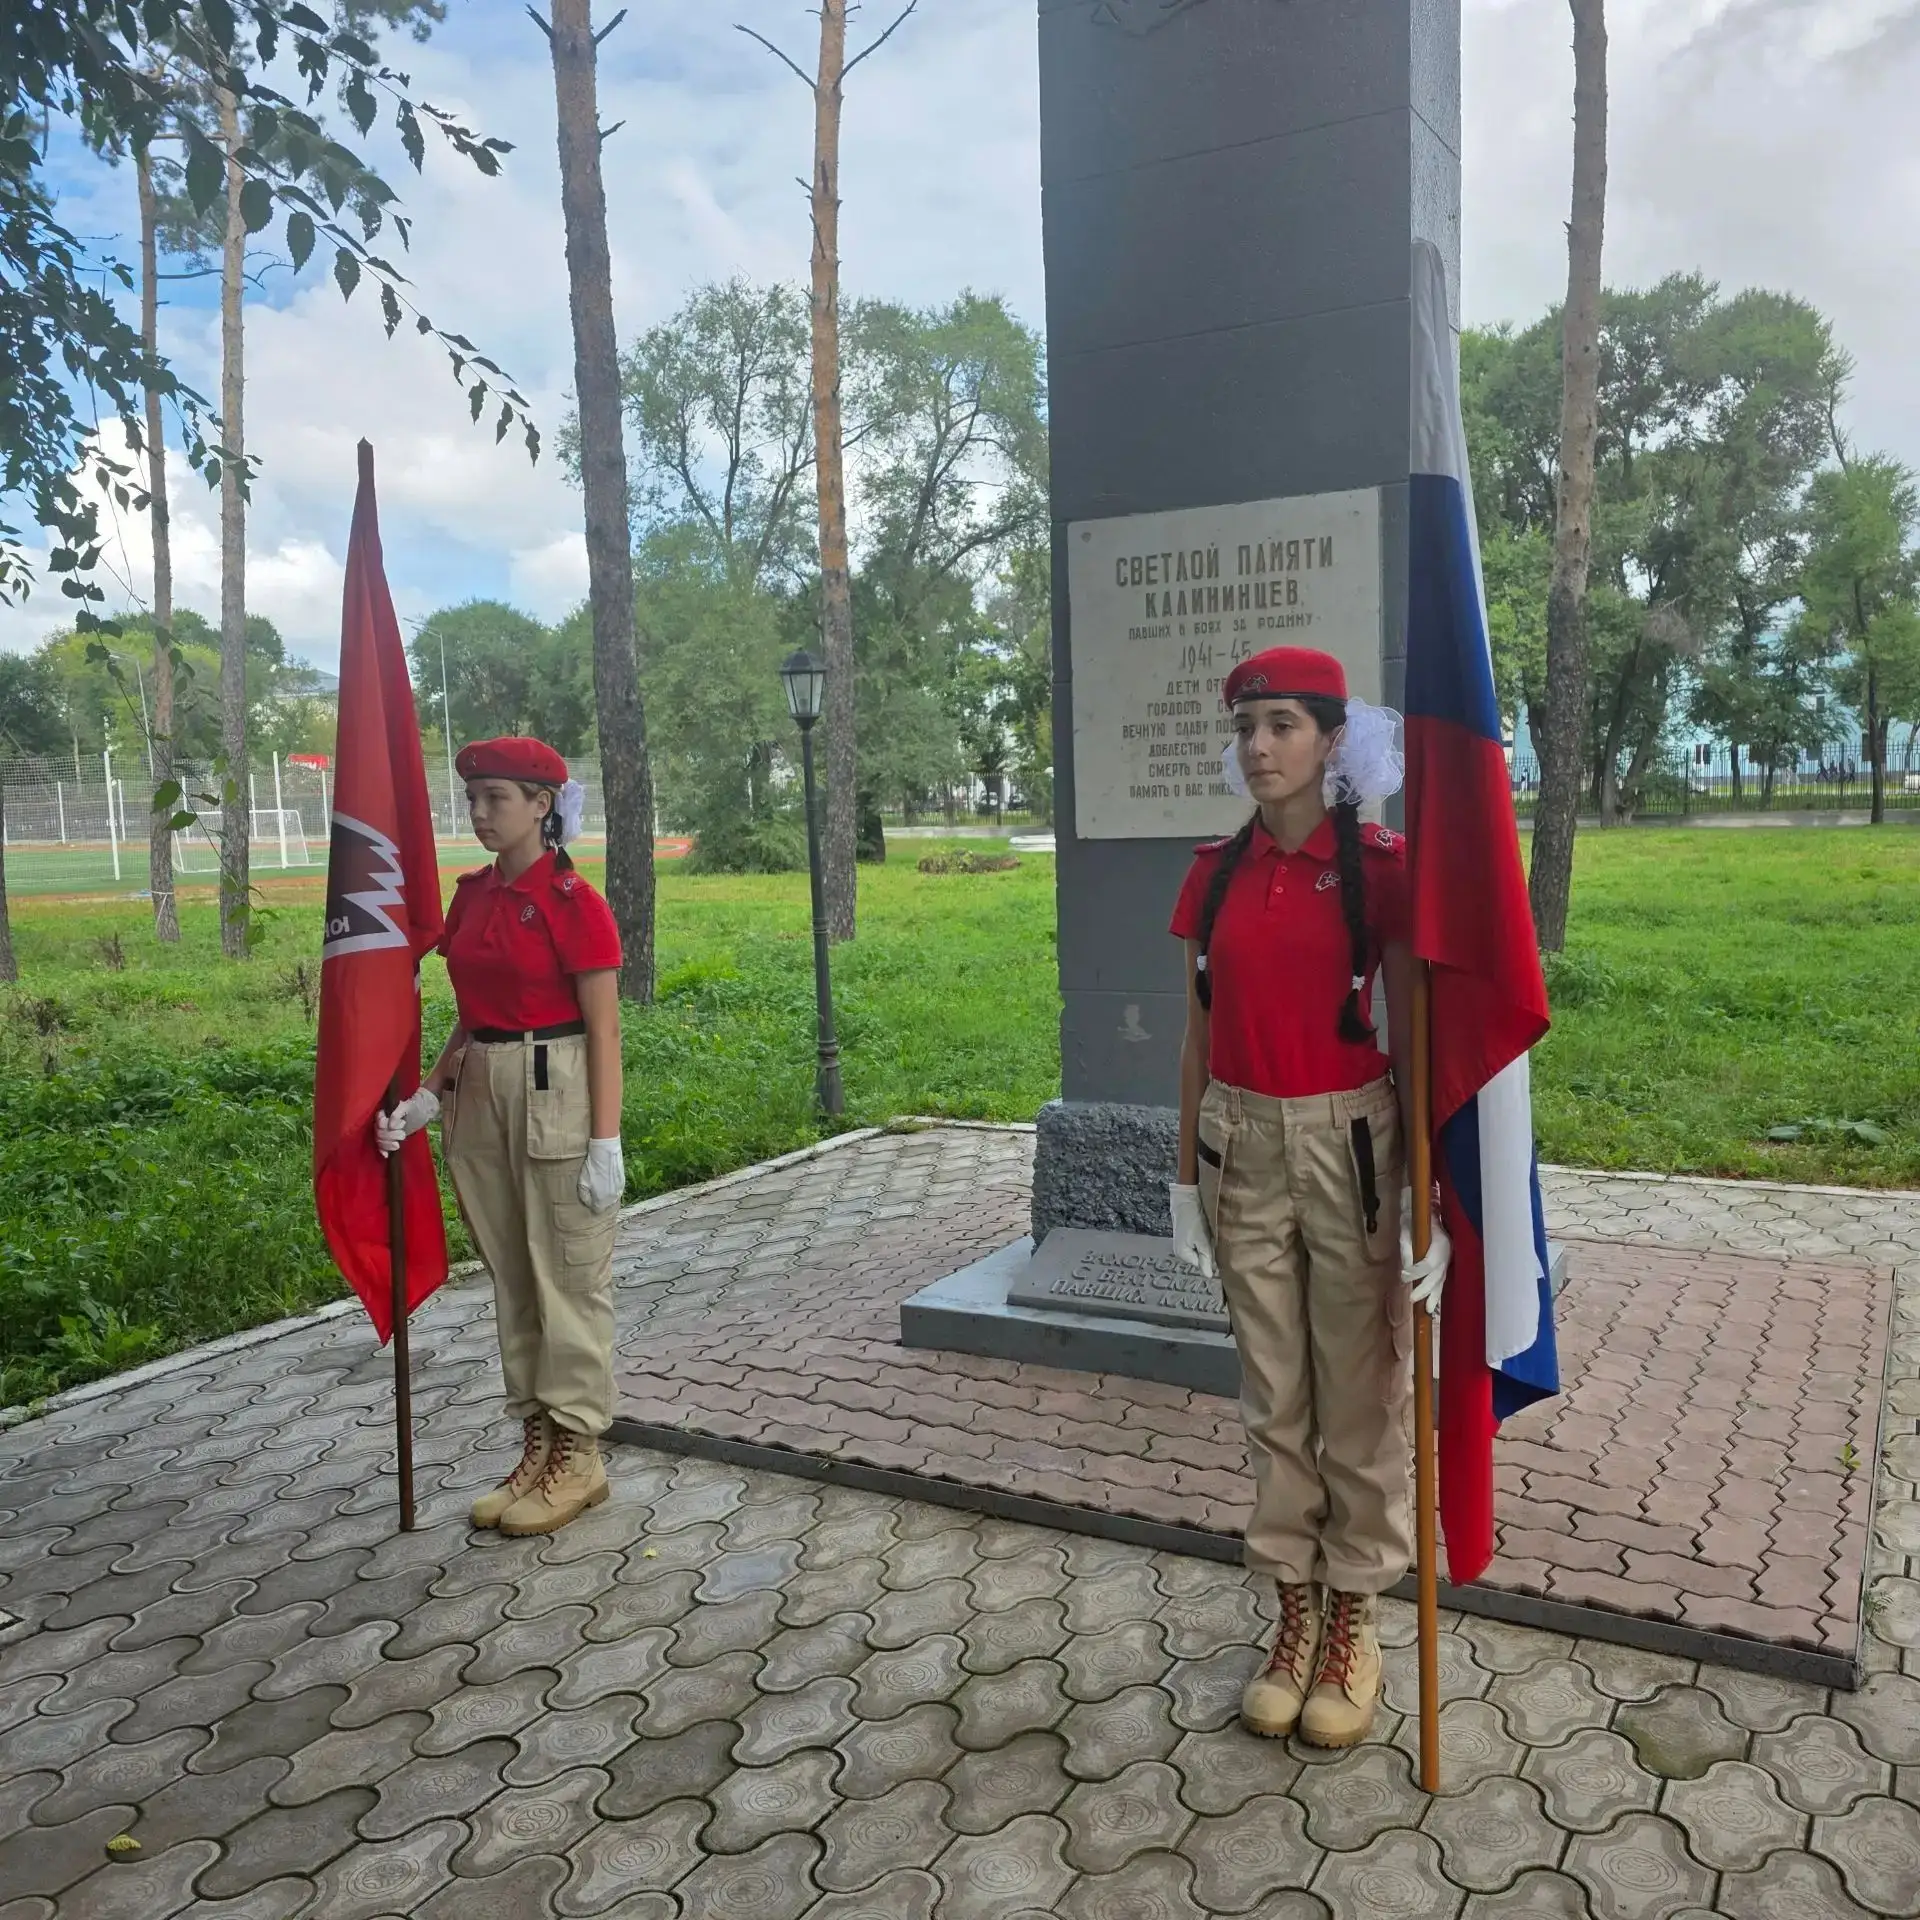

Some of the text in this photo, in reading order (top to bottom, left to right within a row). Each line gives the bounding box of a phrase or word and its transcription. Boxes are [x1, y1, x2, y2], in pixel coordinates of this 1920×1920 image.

[1115, 536, 1333, 588] СВЕТЛОЙ ПАМЯТИ
[1128, 623, 1172, 640] ПАВШИХ
[1194, 619, 1222, 635] БОЯХ
[1232, 618, 1247, 632] ЗА
[1166, 679, 1200, 696] ДЕТИ
[1147, 700, 1202, 717] ГОРДОСТЬ
[1122, 722, 1166, 739] ВЕЧНУЮ
[1175, 720, 1209, 737] СЛАВУ
[1148, 742, 1207, 758] ДОБЛЕСТНО
[1148, 760, 1228, 778] СМЕРТЬ СОКР
[1129, 784, 1170, 799] ПАМЯТЬ
[1174, 783, 1180, 797] О
[1185, 783, 1204, 797] ВАС
[1097, 1268, 1213, 1296] БРАТСКИХ
[1049, 1279, 1146, 1304] ПАВШИХ
